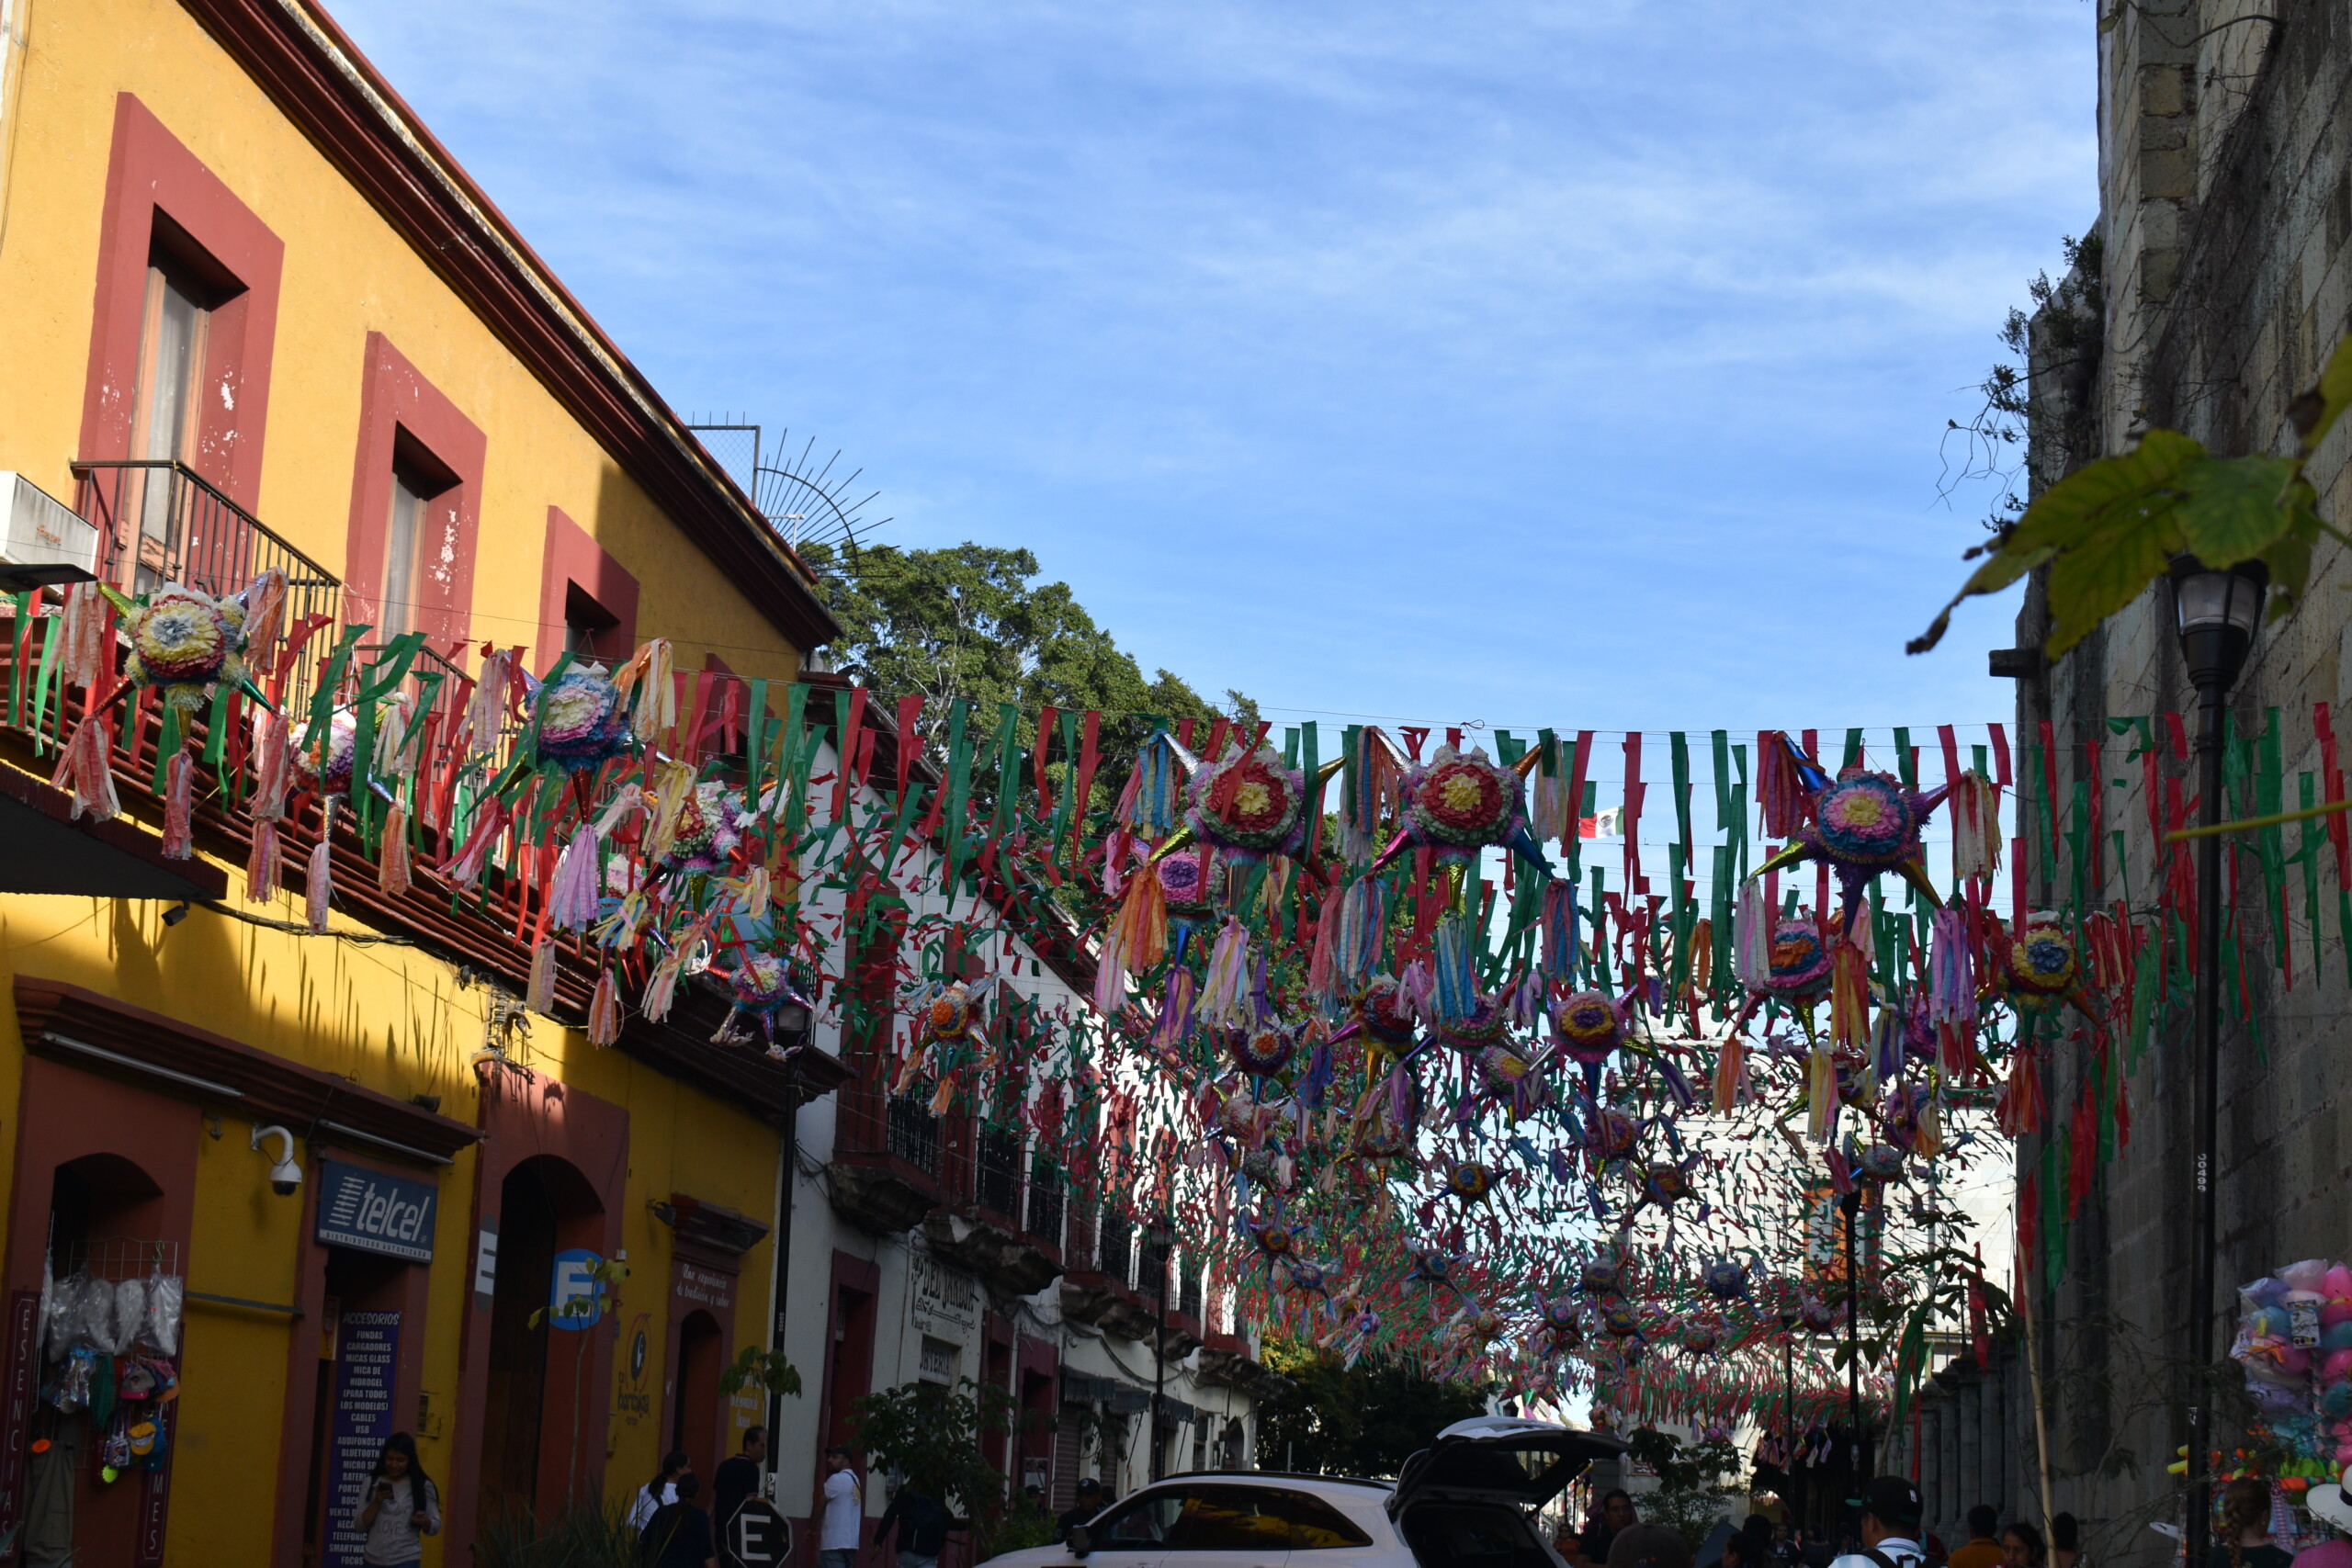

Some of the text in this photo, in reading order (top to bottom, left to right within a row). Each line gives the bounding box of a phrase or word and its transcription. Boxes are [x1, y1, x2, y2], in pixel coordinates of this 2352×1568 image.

[356, 1182, 430, 1242] telcel
[326, 1232, 427, 1258] DISTRIBUIDOR AUTORIZADO
[555, 1260, 598, 1318] E
[343, 1311, 401, 1325] ACCESORIOS
[356, 1330, 384, 1340] FUNDAS
[346, 1341, 391, 1352] CARGADORES
[345, 1353, 391, 1364] MICAS GLASS
[354, 1365, 381, 1375] MICA DE
[350, 1377, 383, 1387] HIDROGEL
[344, 1389, 388, 1399] (PARA TODOS
[340, 1401, 389, 1411] LOS MODELOS)
[351, 1413, 377, 1423] CABLES
[356, 1425, 370, 1434] USB
[341, 1448, 380, 1458] BLUETOOTH
[343, 1461, 366, 1470] MICRO
[338, 1484, 359, 1494] PORTA
[329, 1507, 351, 1517] VENTA
[337, 1519, 356, 1529] RECA
[333, 1531, 368, 1541] TELEFONIC
[741, 1513, 772, 1561] E
[329, 1544, 365, 1554] SMARTWA
[341, 1556, 364, 1566] FOCOS
